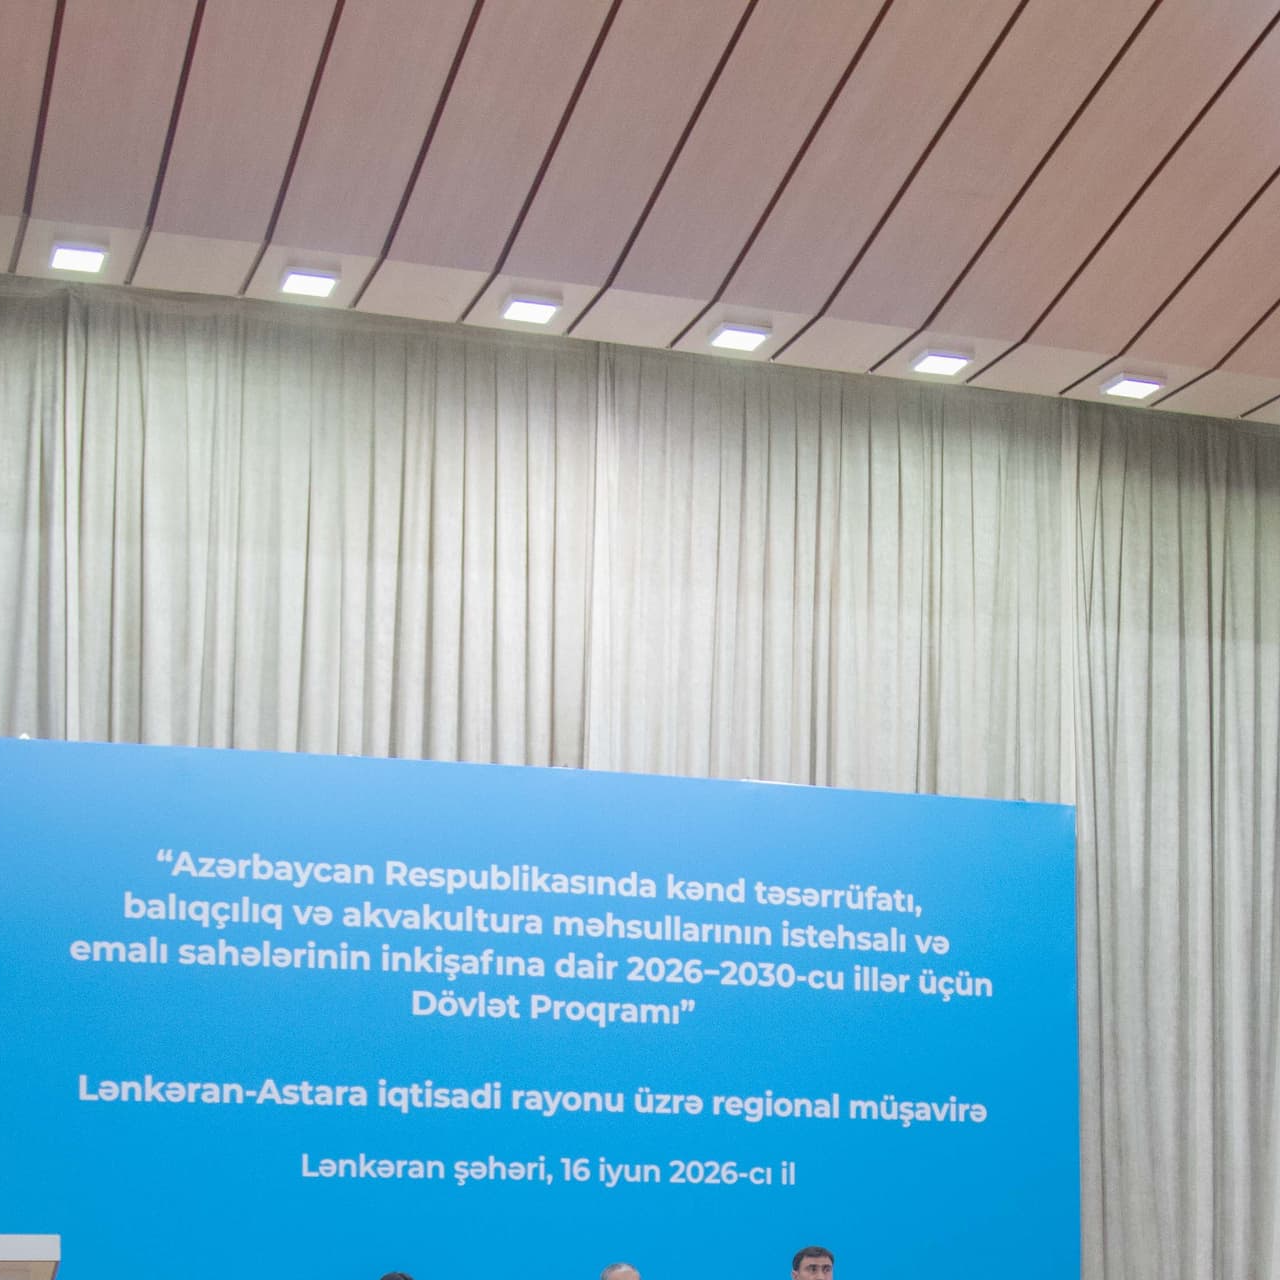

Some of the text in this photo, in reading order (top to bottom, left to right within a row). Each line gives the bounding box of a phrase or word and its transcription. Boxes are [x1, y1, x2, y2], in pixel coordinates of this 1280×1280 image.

[155, 848, 923, 919] “Azərbaycan Respublikasında kənd təsərrüfatı,
[123, 890, 951, 956] balıqçılıq və akvakultura məhsullarının istehsalı və
[68, 935, 169, 965] emalı
[177, 938, 372, 972] sahələrinin
[380, 942, 546, 982] inkişafına
[553, 951, 620, 981] dair
[852, 963, 912, 994] illər
[917, 967, 994, 1003] üçün
[411, 988, 697, 1030] Dövlət Proqramı”
[77, 1073, 988, 1129] Lənkəran-Astara iqtisadi rayonu üzrə regional müşavirə
[301, 1152, 796, 1189] Lənkəran şəhəri, 16 iyun 2026-cı il
